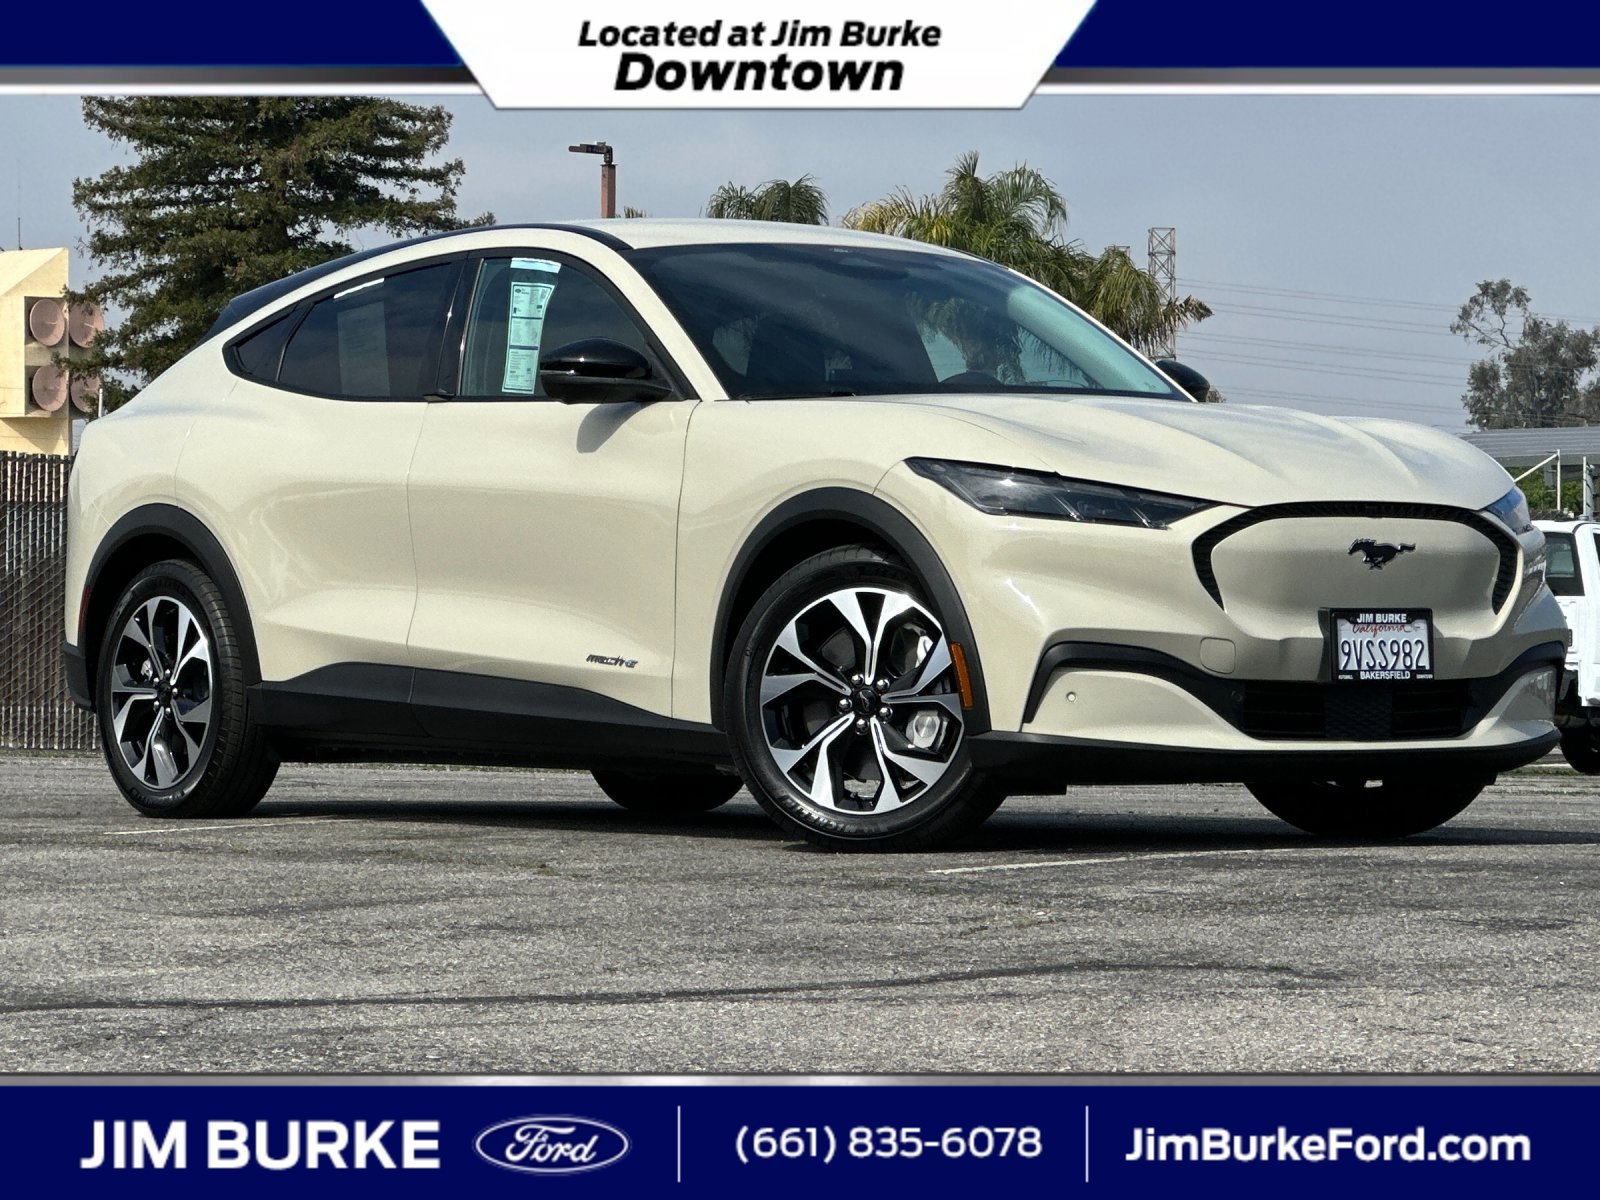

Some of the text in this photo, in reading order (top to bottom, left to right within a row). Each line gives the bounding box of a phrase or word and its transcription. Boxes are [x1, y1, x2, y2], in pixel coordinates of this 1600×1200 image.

[1356, 613, 1408, 624] JIM BURKE
[1352, 623, 1411, 638] California
[1341, 639, 1426, 671] 9VSS982
[1360, 670, 1411, 680] BAKERSFIELD
